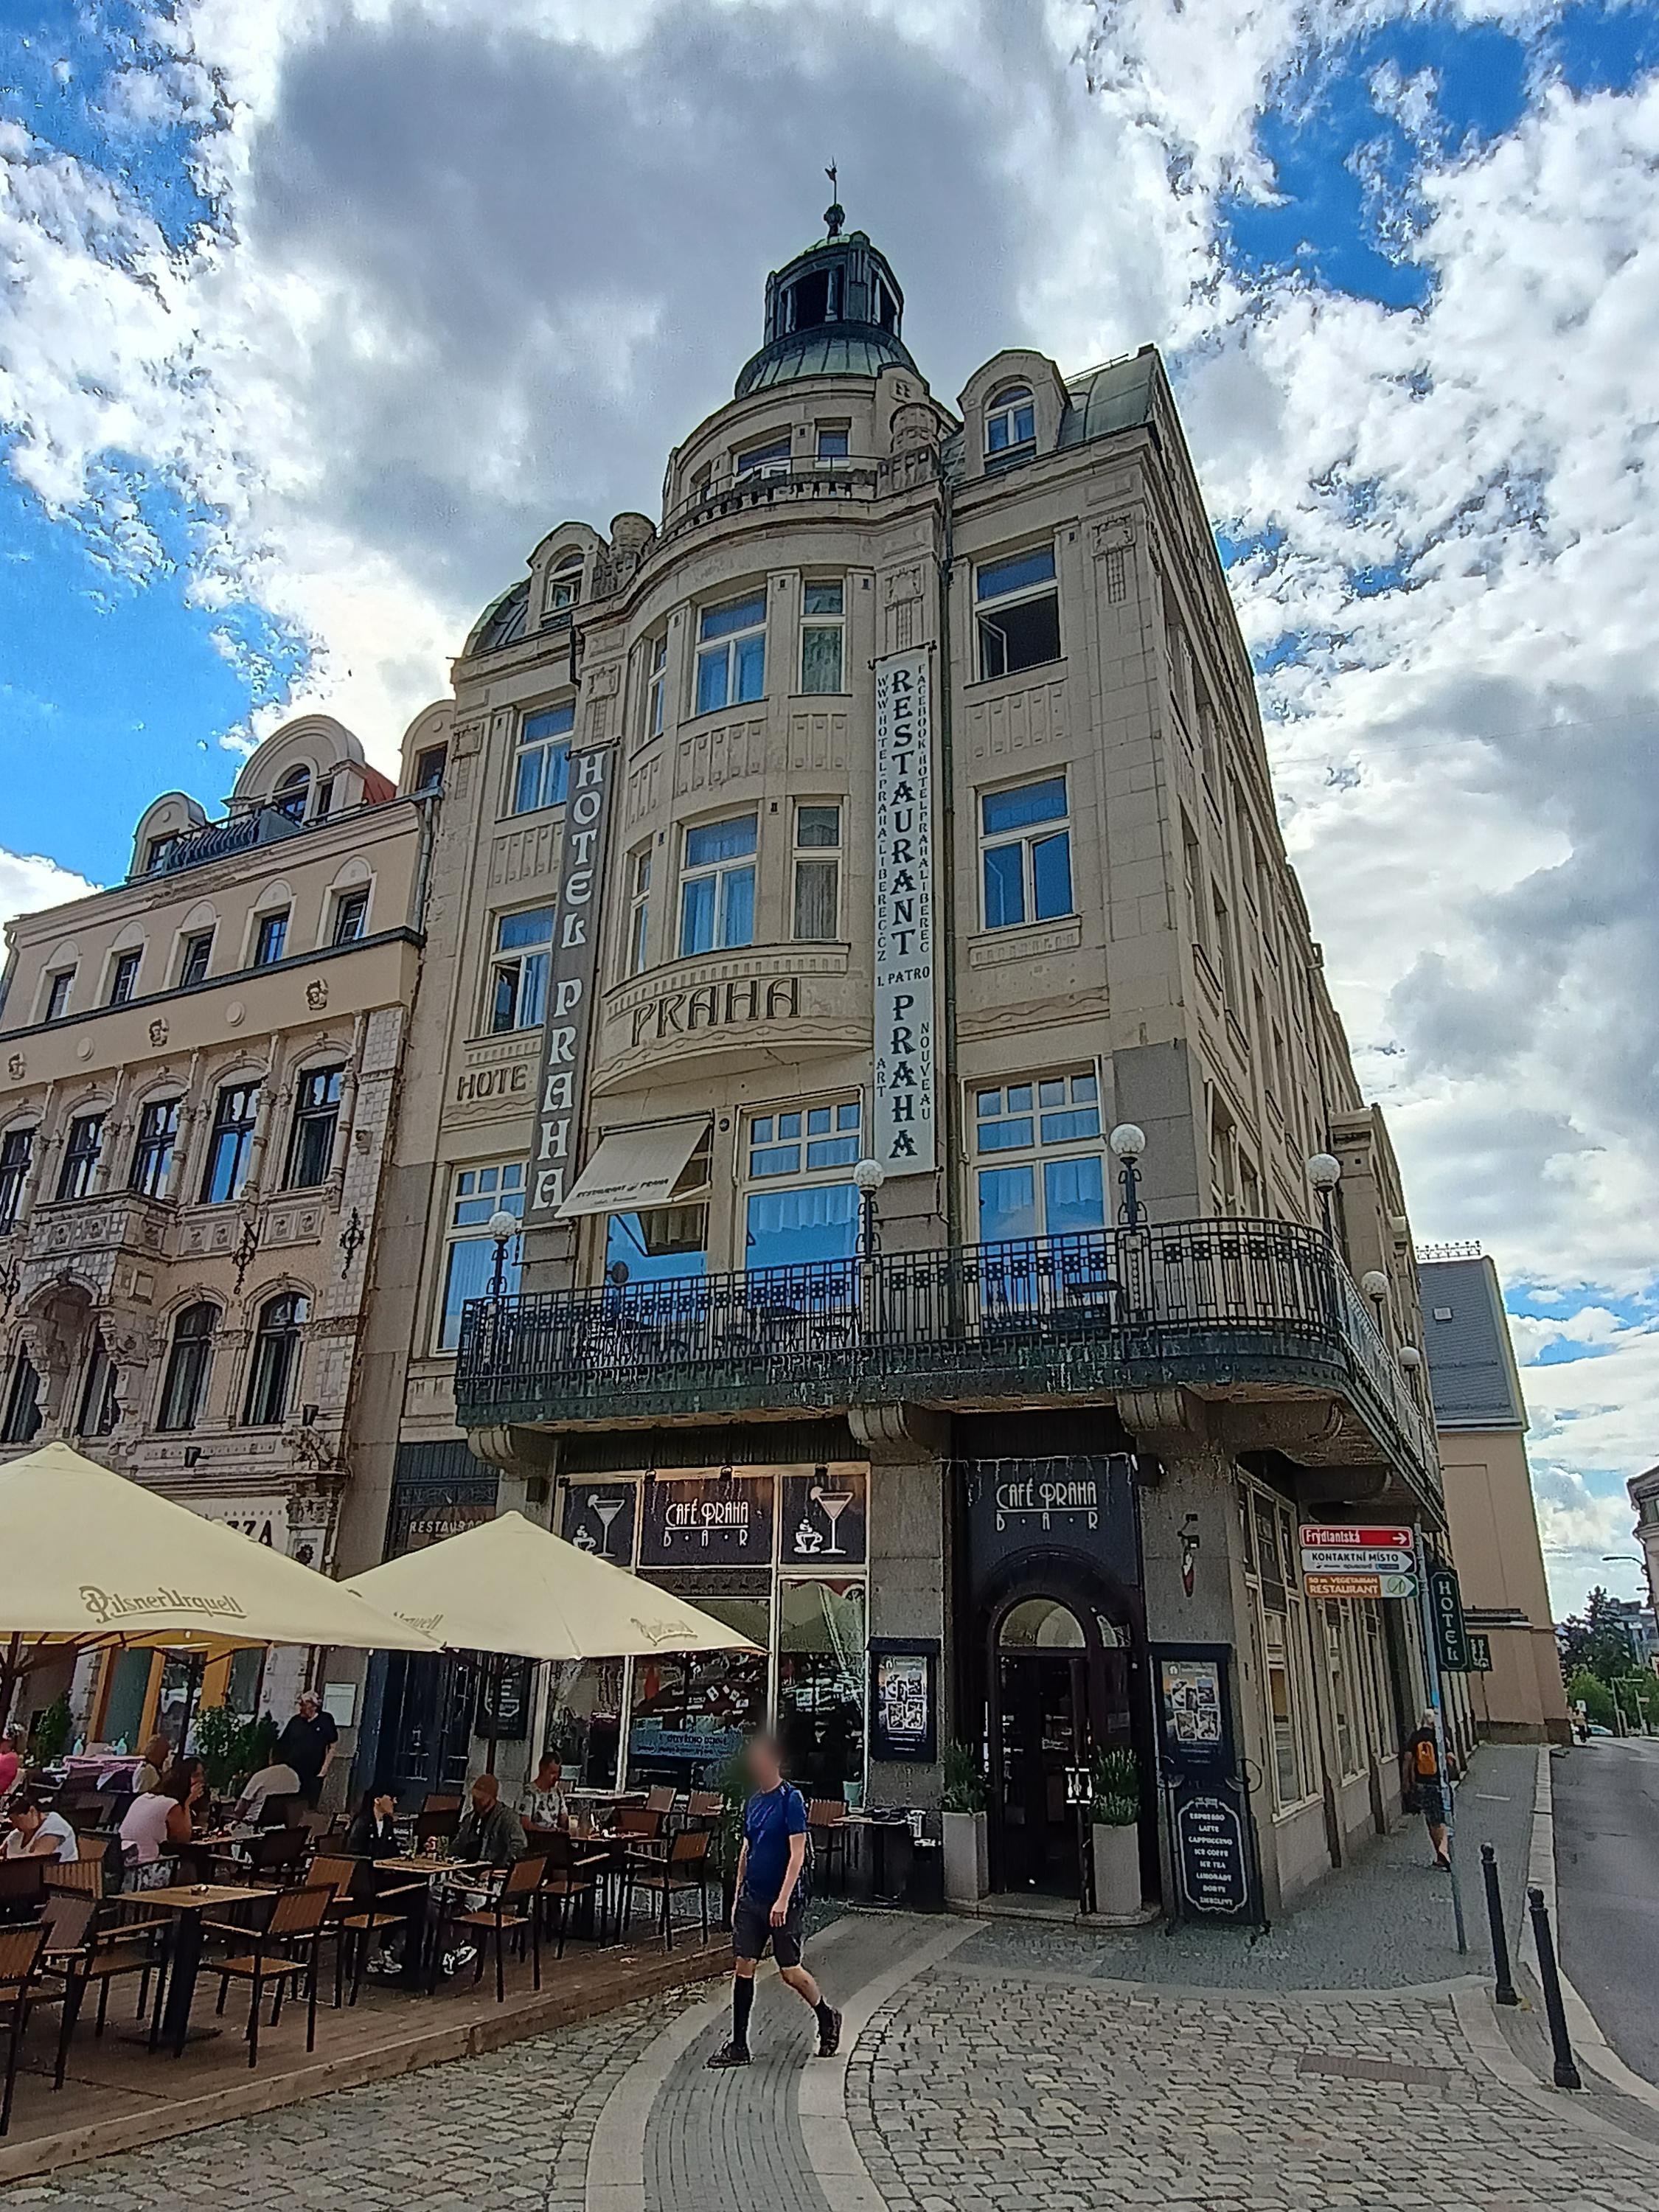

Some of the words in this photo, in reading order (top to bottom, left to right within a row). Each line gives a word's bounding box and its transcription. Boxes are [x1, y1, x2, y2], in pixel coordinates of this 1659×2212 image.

[890, 669, 917, 956] RESTAURANT
[560, 751, 607, 949] HOTEL
[888, 965, 931, 984] PATRO
[632, 977, 800, 1047] PRAHA
[530, 978, 582, 1211] PRAHA
[876, 1057, 887, 1097] ART
[919, 1022, 931, 1120] NOUVEAU
[888, 995, 918, 1158] PRAHA
[665, 1498, 698, 1526] CAFÉ
[701, 1501, 748, 1526] PRAHA
[996, 1478, 1034, 1509] CAFÉ
[1039, 1481, 1097, 1510] PRAHA
[1306, 1530, 1360, 1545] Frýdlantská
[1312, 1551, 1366, 1562] KONTAKTNÍ
[1369, 1551, 1399, 1562] MÍSTO
[79, 1585, 167, 1624] Pilsner
[158, 1587, 244, 1617] Urquell
[1310, 1585, 1378, 1593] RESTAURANT
[1439, 1581, 1458, 1660] HOTEL
